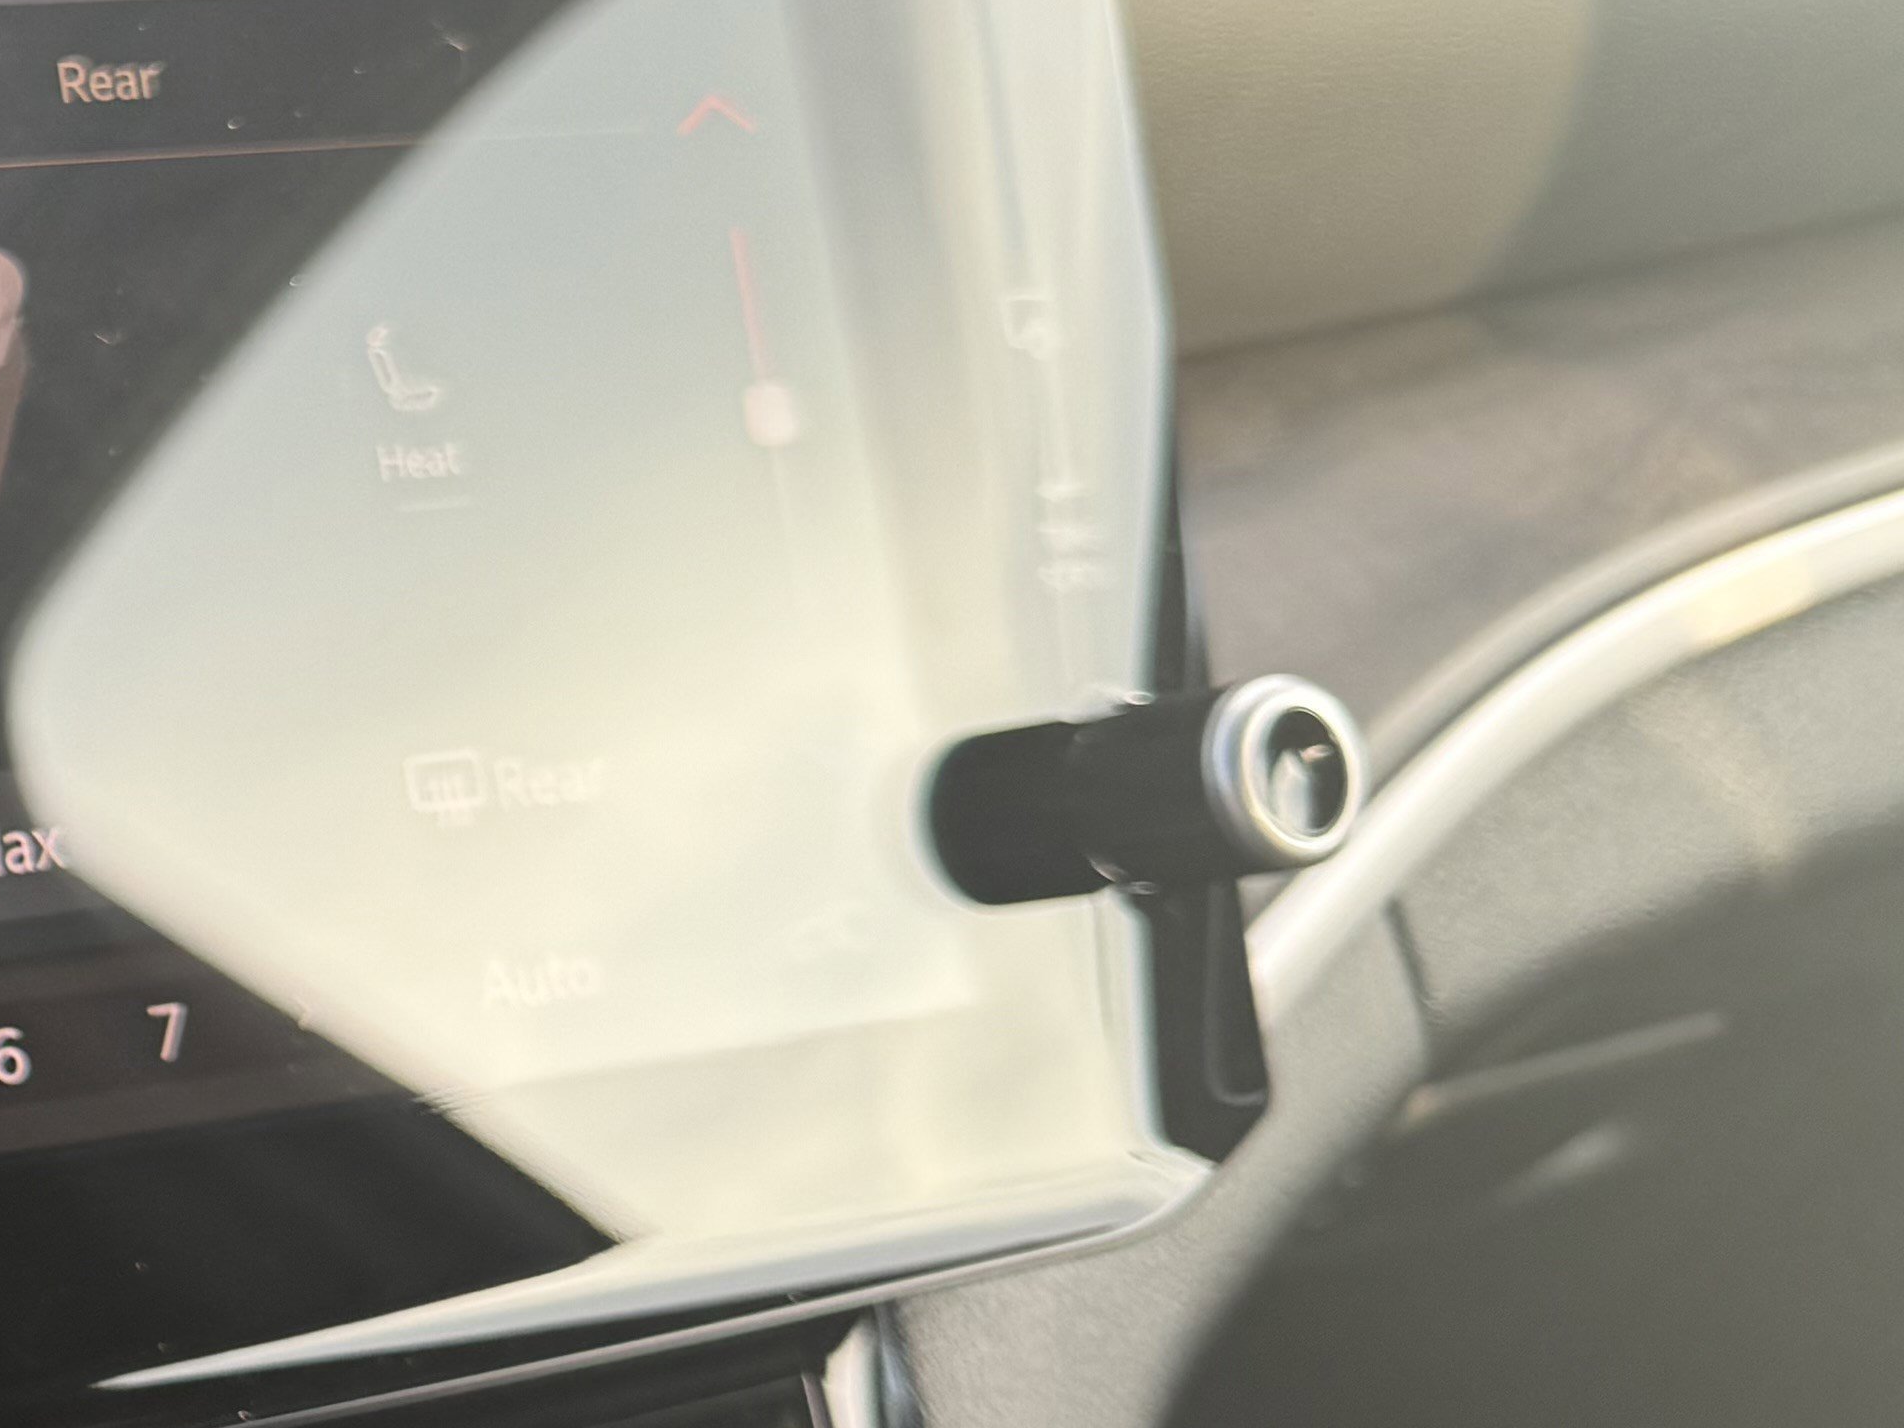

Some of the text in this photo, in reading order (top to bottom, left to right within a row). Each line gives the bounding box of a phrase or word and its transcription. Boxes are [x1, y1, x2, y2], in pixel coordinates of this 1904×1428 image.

[55, 56, 164, 107] Rear
[376, 440, 466, 483] Heat
[146, 1001, 188, 1062] 7
